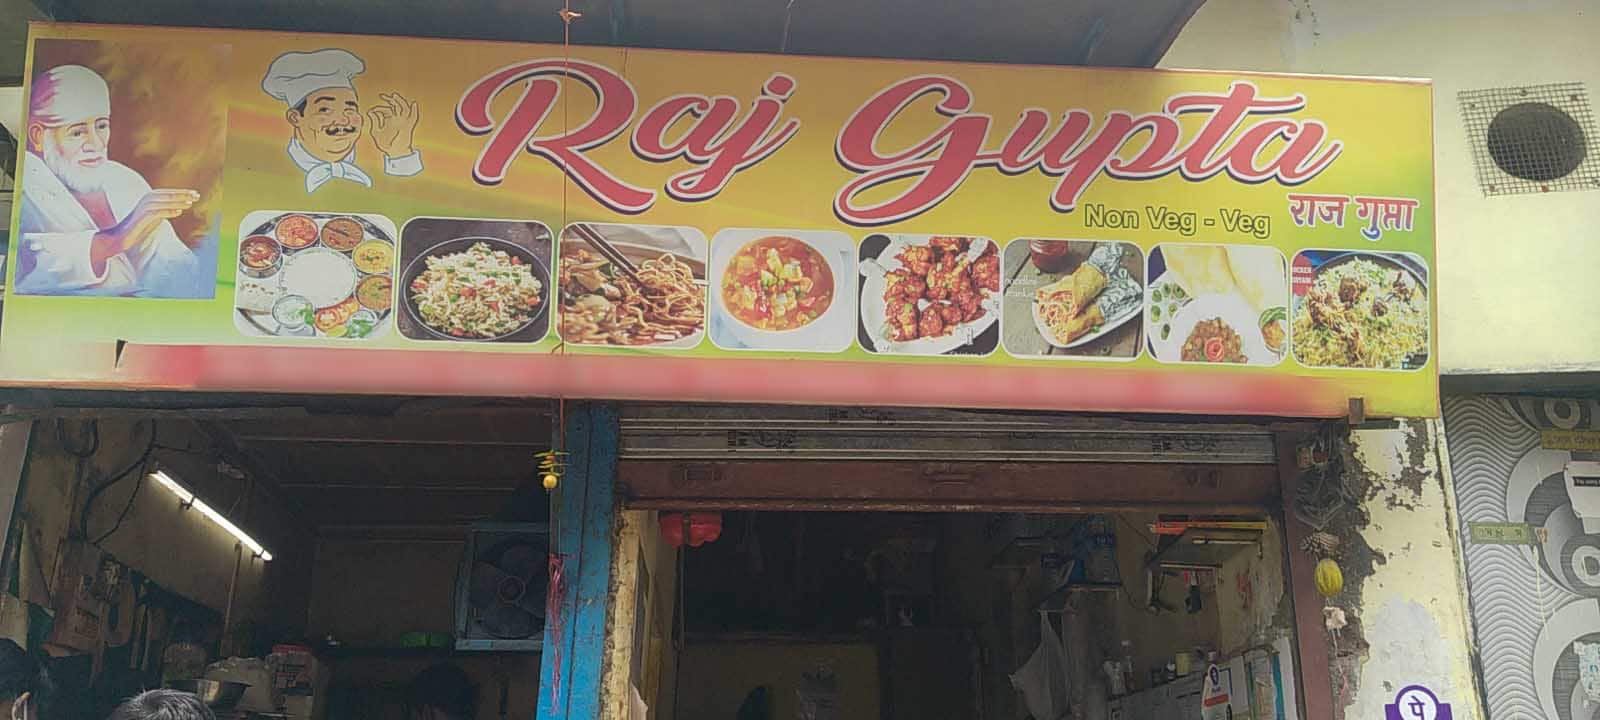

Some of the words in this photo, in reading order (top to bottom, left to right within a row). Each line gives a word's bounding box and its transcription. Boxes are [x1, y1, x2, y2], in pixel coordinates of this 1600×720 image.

[455, 58, 801, 214] Raj
[834, 75, 1343, 227] Gupta
[1084, 204, 1139, 229] Non
[1146, 206, 1197, 236] Veg
[1220, 209, 1271, 239] Veg
[1289, 194, 1350, 227] राज
[1354, 197, 1418, 240] गुप्ता
